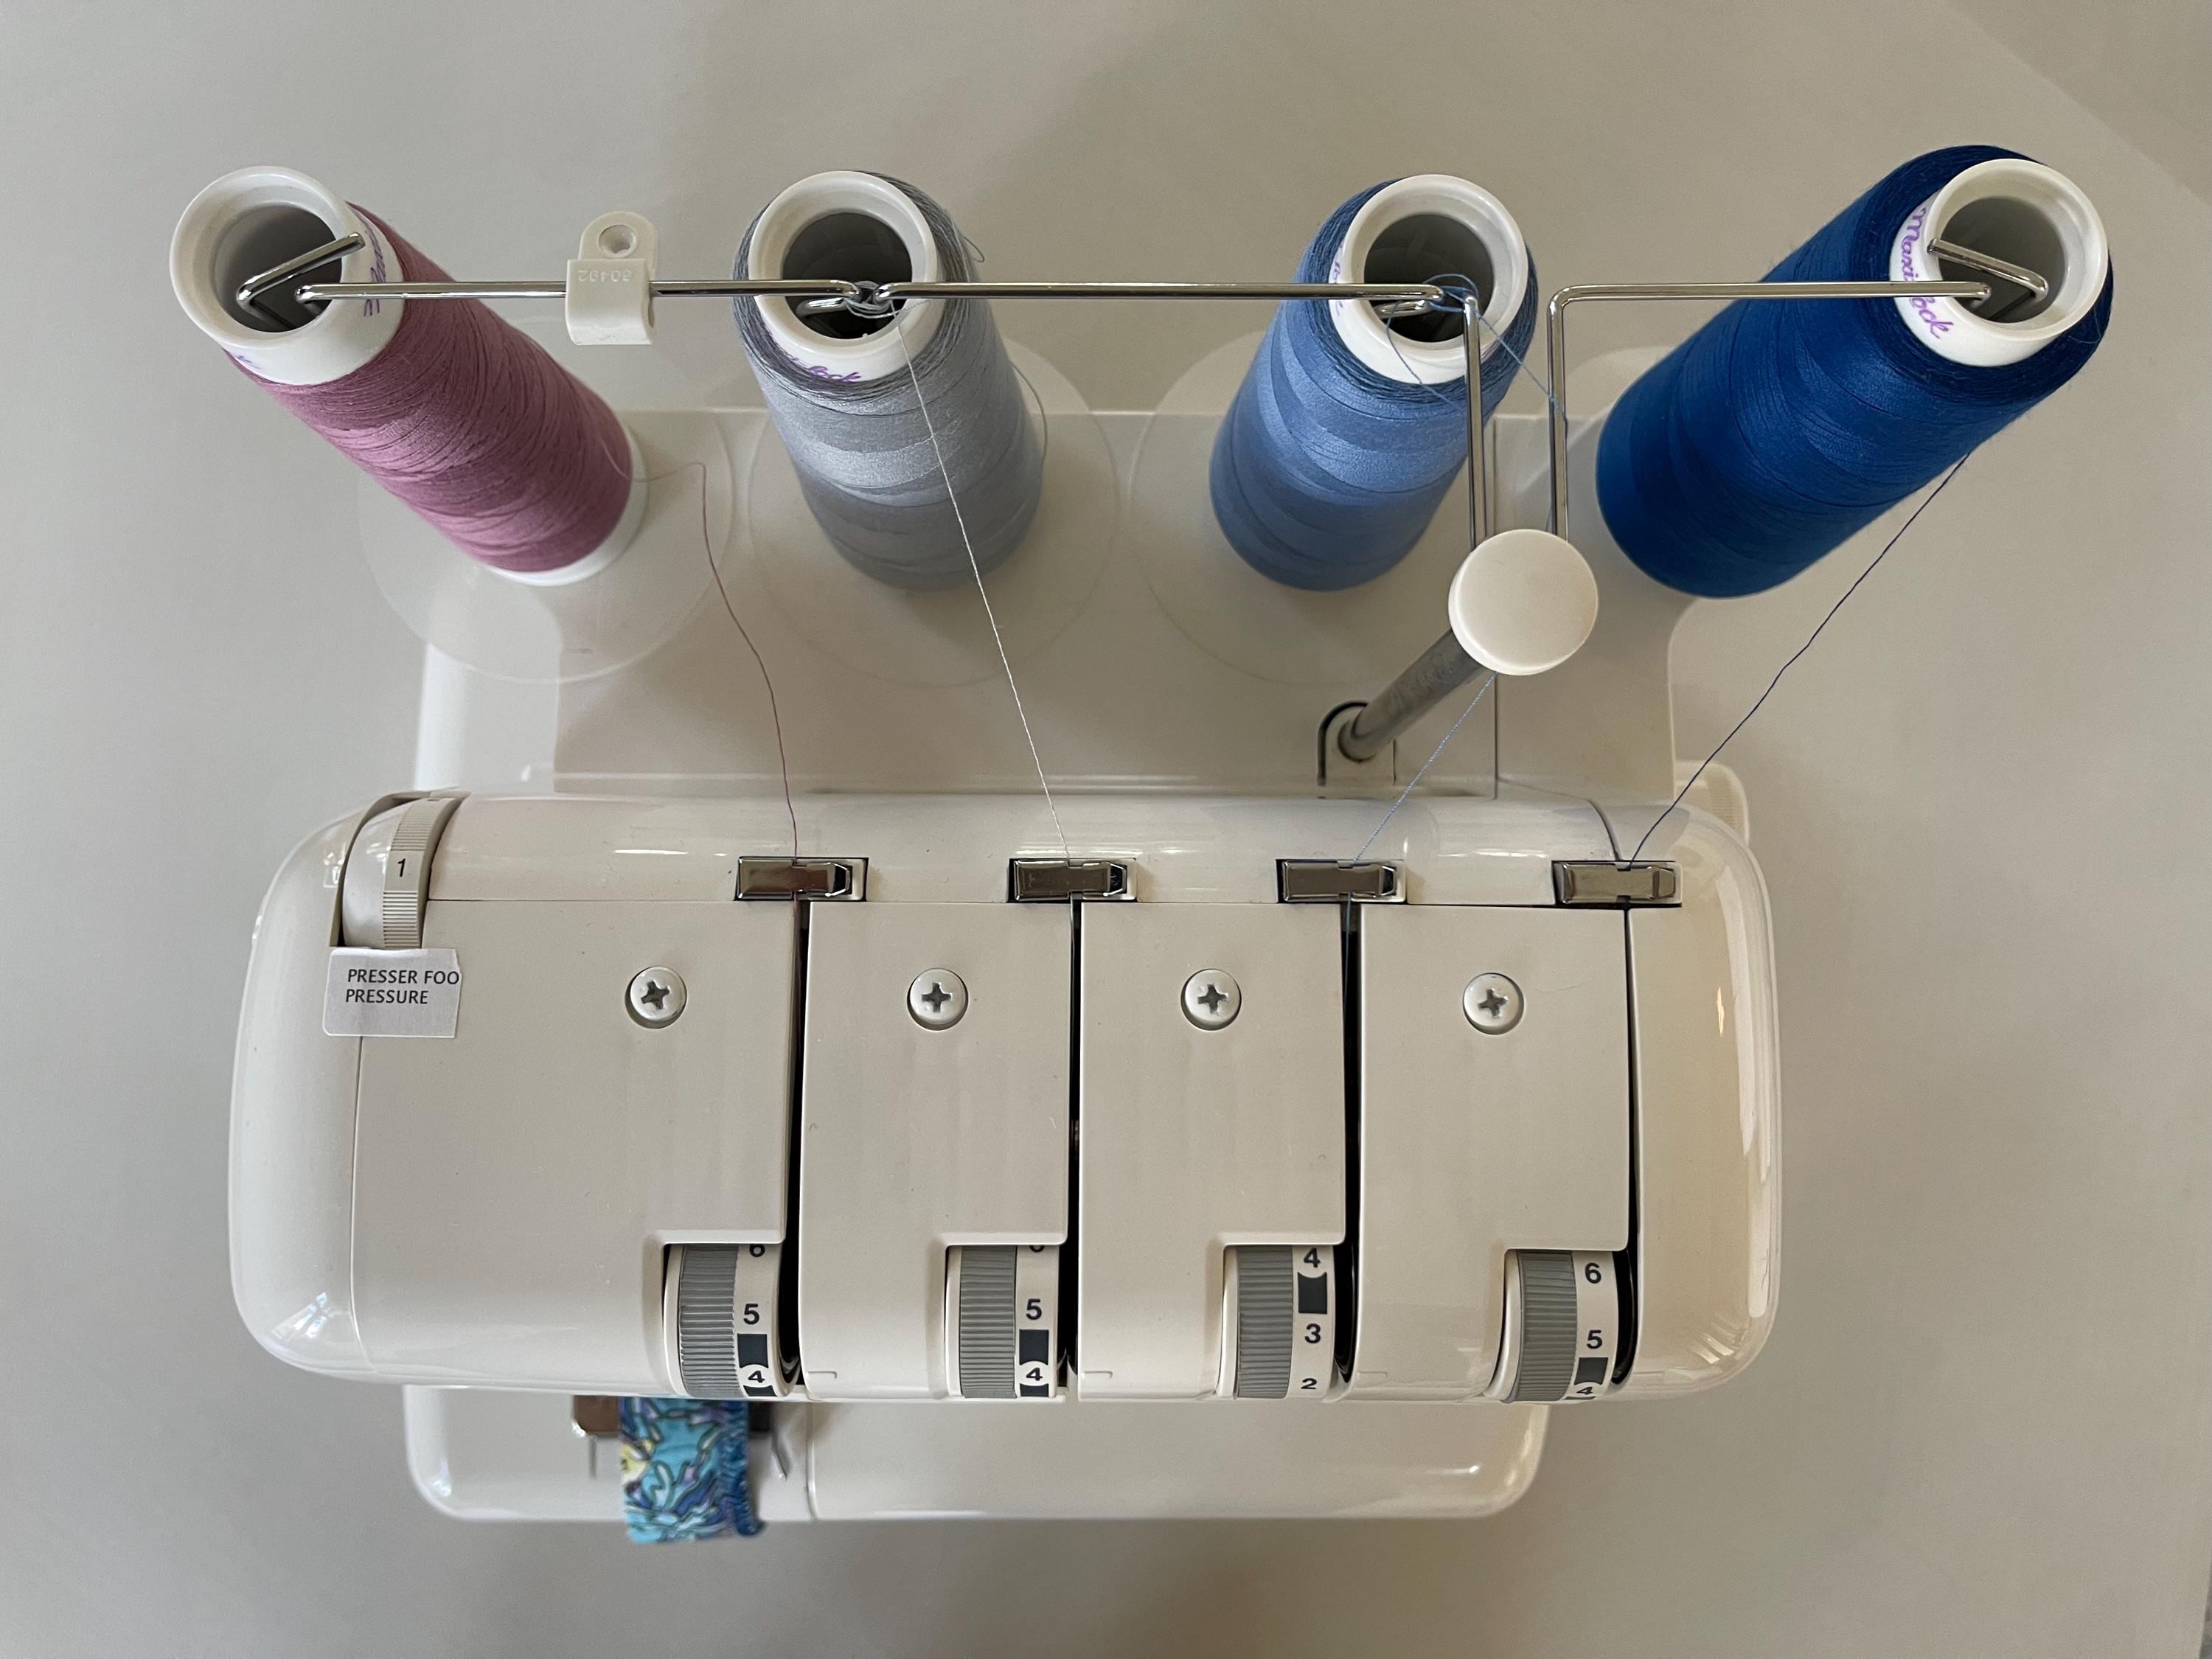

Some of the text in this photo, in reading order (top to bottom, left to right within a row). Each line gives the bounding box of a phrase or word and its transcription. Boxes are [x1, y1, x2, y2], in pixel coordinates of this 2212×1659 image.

[397, 858, 406, 877] 1
[347, 968, 418, 984] PRESSER
[345, 988, 429, 1004] PRESSURE
[1303, 1247, 1321, 1268] 4
[1584, 1262, 1602, 1284] 6
[742, 1303, 760, 1325] 5
[1026, 1298, 1043, 1320] 5
[1304, 1323, 1322, 1344] 3
[1585, 1329, 1603, 1349] 5
[747, 1370, 765, 1383] 4
[1025, 1367, 1043, 1382] 4
[1300, 1377, 1318, 1390] 2
[1576, 1386, 1593, 1395] 4
